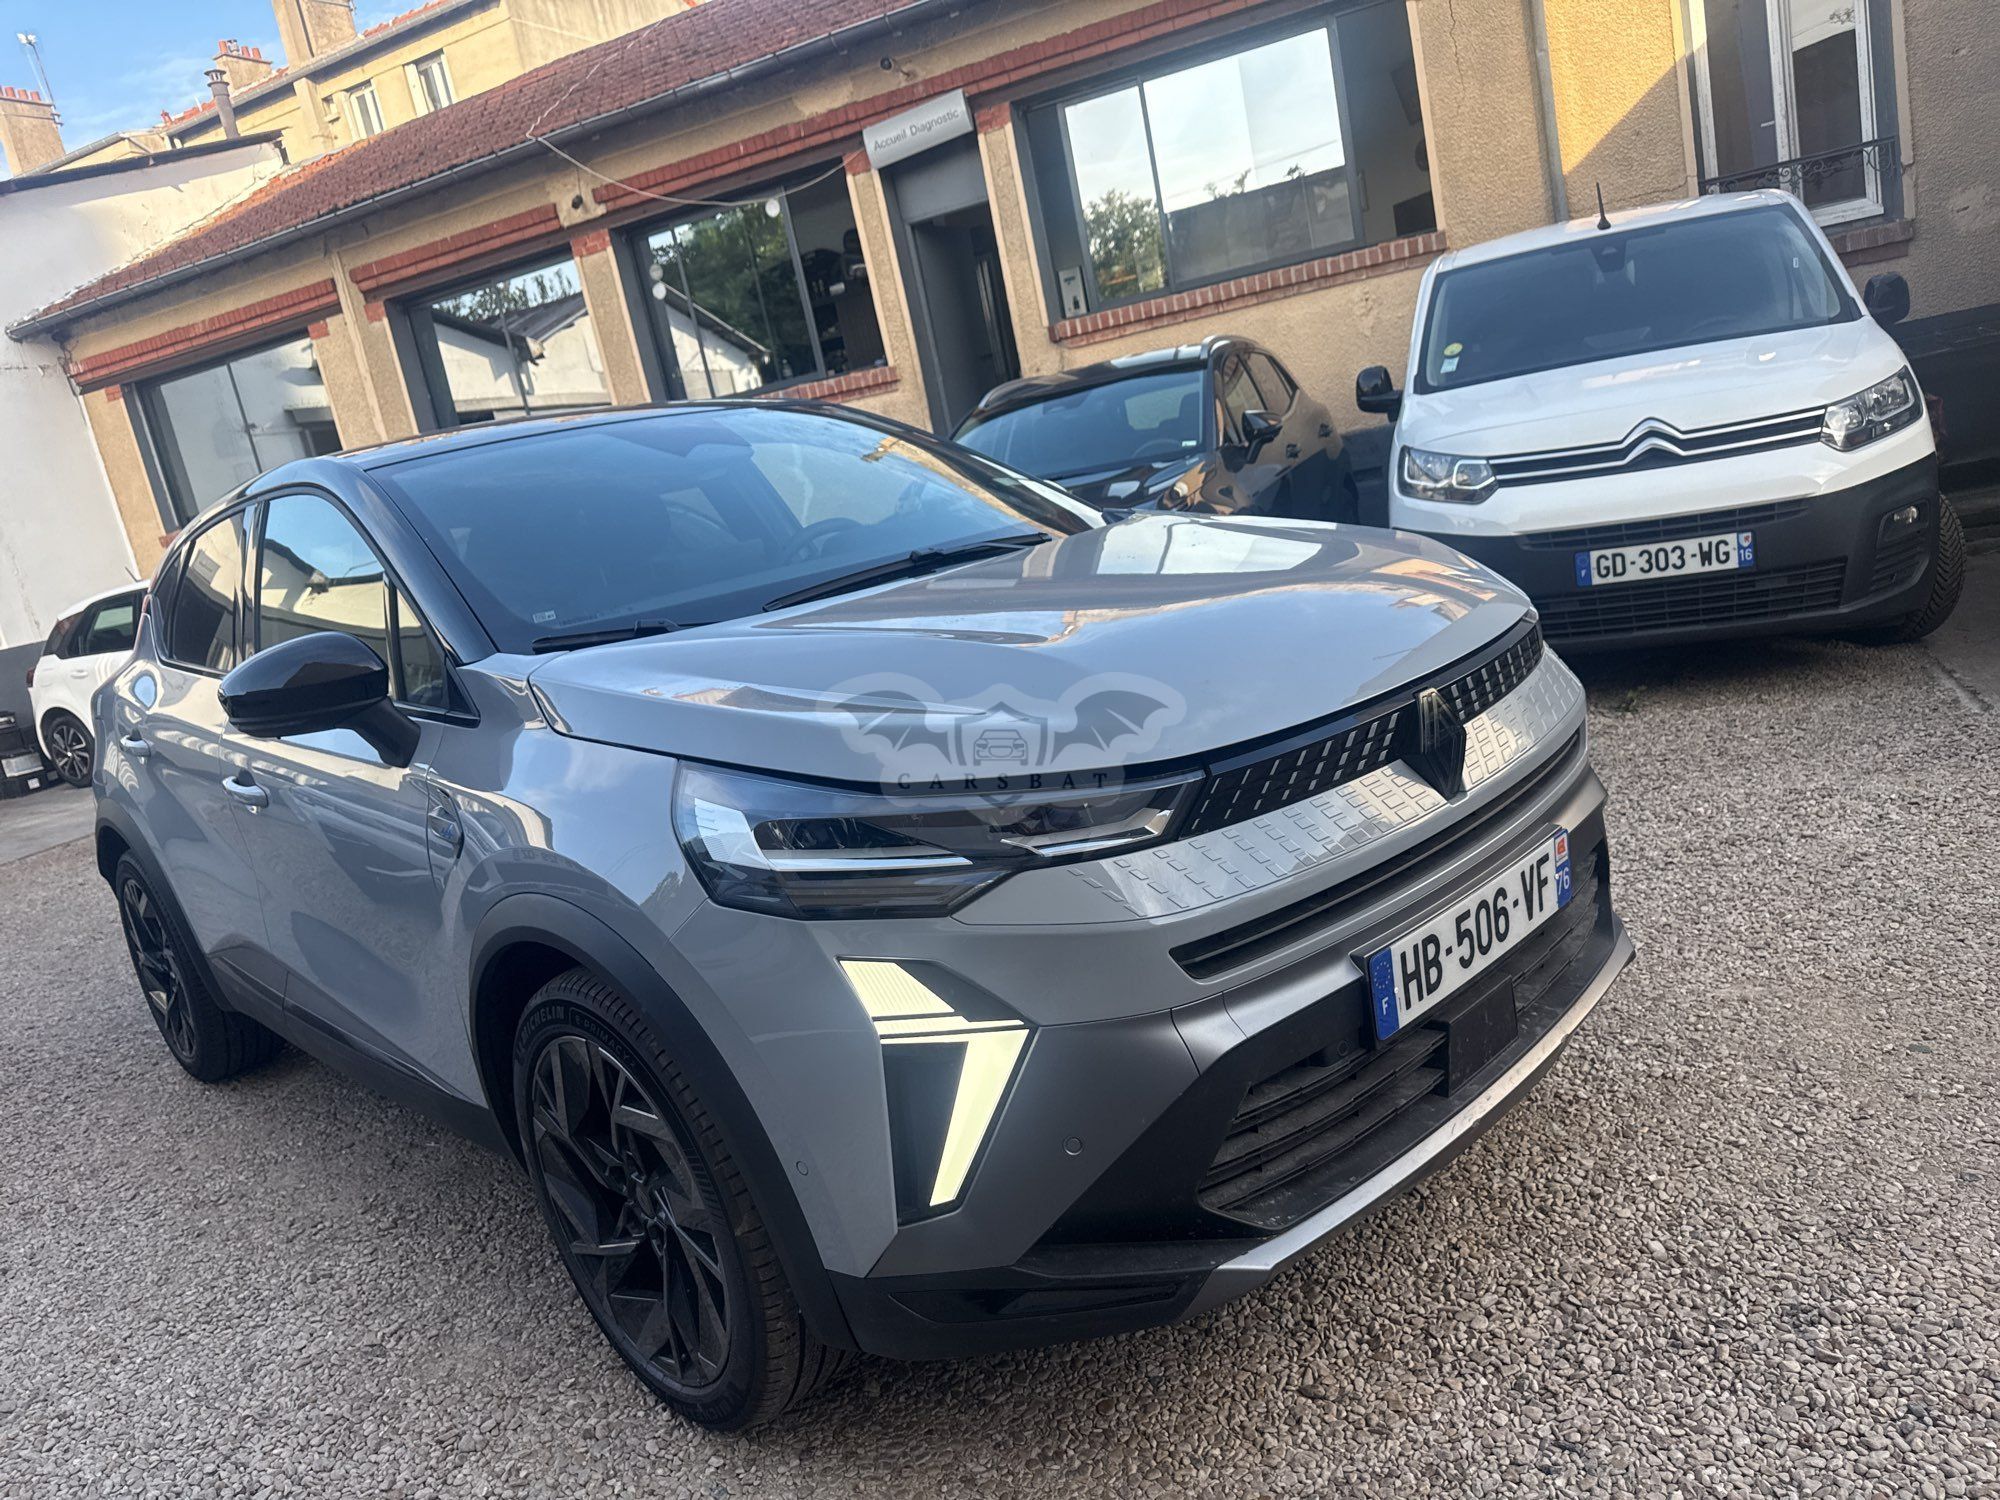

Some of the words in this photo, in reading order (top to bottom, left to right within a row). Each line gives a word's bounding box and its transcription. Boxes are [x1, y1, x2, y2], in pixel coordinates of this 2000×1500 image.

[874, 129, 906, 151] Accueil
[910, 109, 959, 136] Diagnostic
[1596, 539, 1731, 578] GD-303-WG
[1739, 548, 1753, 561] 16
[1381, 996, 1389, 1015] F
[1400, 852, 1549, 1010] HB-506-VF
[1556, 867, 1570, 896] 76
[520, 1006, 564, 1041] MICHELIN
